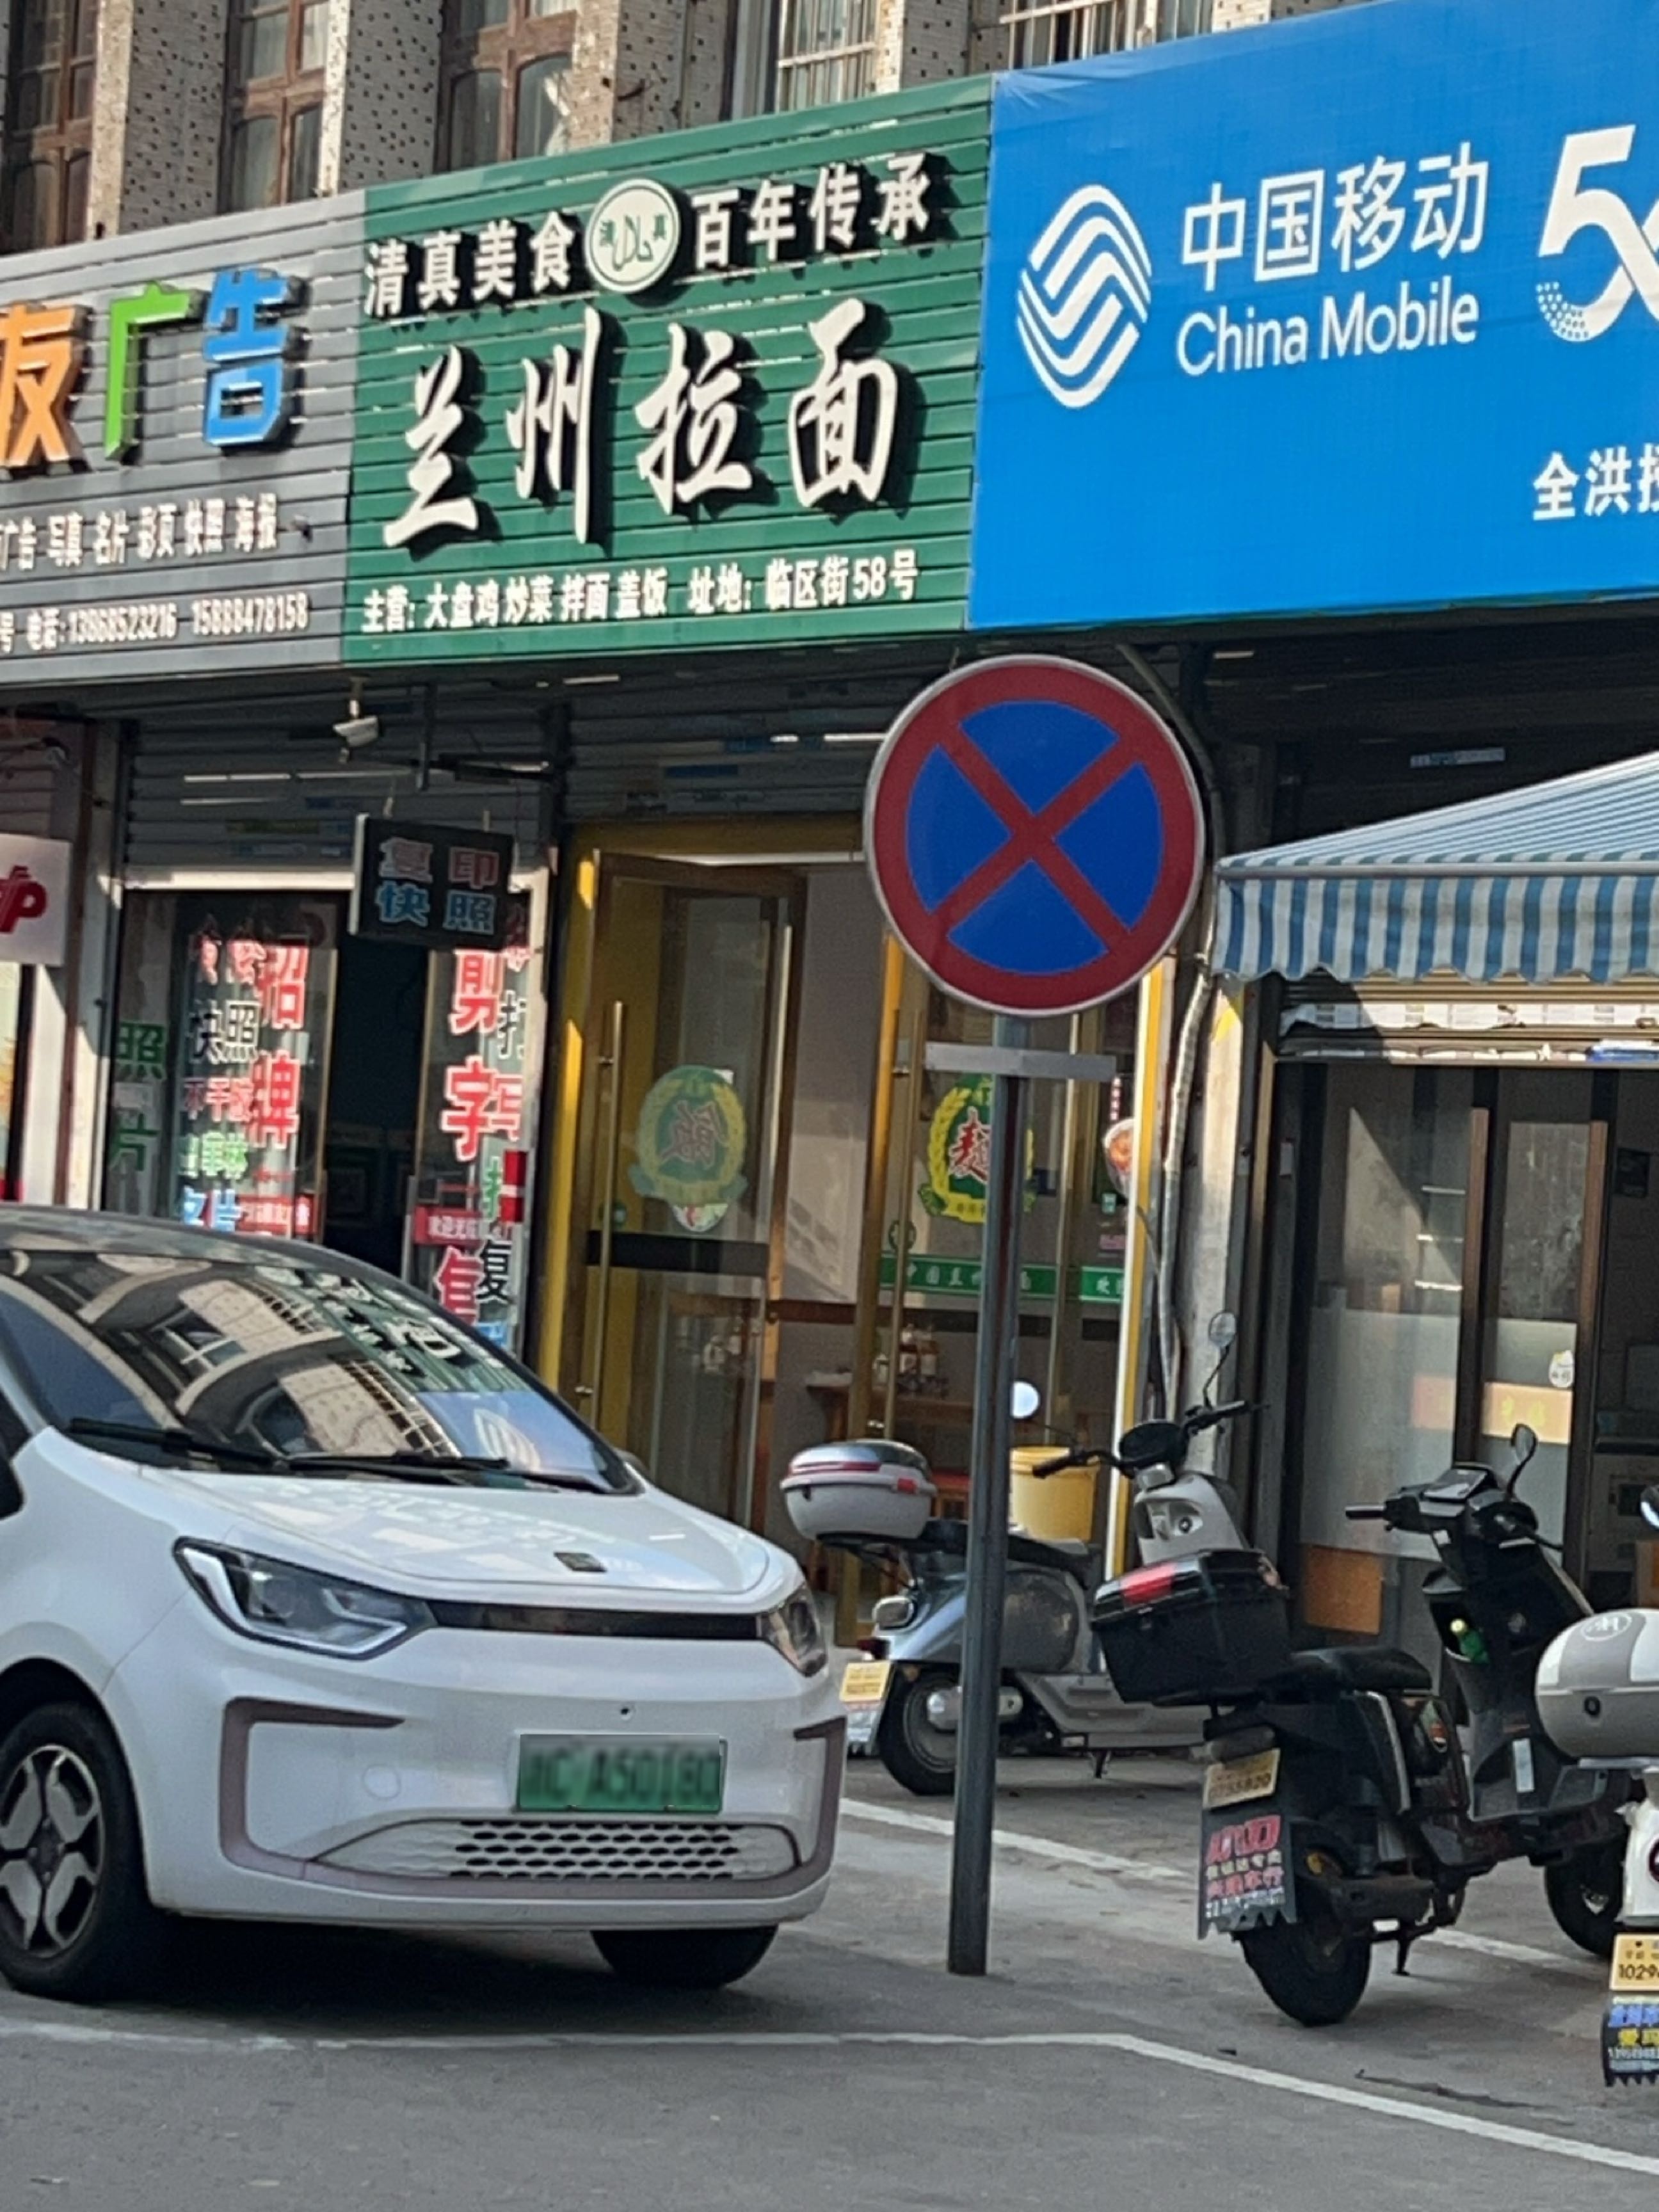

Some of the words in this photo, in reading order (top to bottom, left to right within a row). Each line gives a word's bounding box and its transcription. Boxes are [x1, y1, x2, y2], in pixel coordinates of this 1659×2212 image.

[691, 152, 931, 269] 百年传承
[1181, 141, 1489, 293] 中国移动
[364, 211, 575, 317] 清真美食
[1176, 305, 1307, 376] China
[1319, 275, 1479, 361] Mobile
[383, 297, 897, 548] 兰州拉面
[94, 509, 129, 565] 名片
[374, 880, 497, 935] 快照
